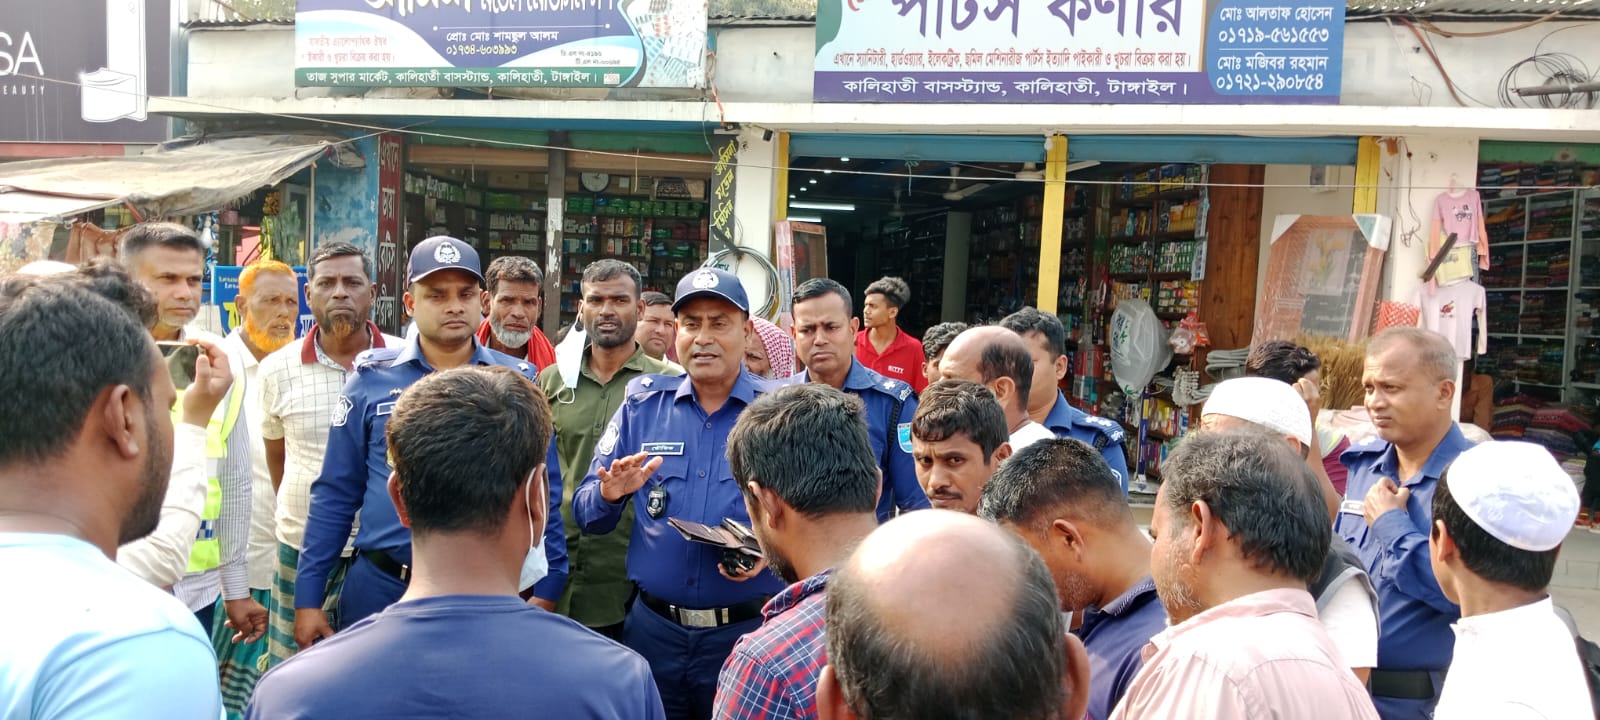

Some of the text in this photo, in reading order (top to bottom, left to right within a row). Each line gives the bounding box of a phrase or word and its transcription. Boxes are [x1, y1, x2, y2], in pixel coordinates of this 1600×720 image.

[1245, 6, 1291, 21] আলতাফ
[1295, 7, 1334, 21] হোসেন
[529, 31, 559, 42] আলম
[1218, 27, 1330, 43] ০১৭১৯-৫৬১৫৫৩
[833, 53, 854, 66] এখানে
[1046, 48, 1070, 67] ইত্যাদি
[1073, 48, 1102, 67] পাইকারী
[1105, 54, 1111, 65] ও
[1114, 53, 1131, 69] খুচরা
[1135, 49, 1155, 67] বিক্রয়
[1158, 53, 1172, 66] করা
[1245, 51, 1286, 71] মজিবর
[1289, 56, 1329, 71] রহমান
[306, 73, 328, 83] তাজ
[330, 72, 356, 84] সুপার
[358, 69, 392, 84] মার্কেট,
[395, 69, 441, 83] কালিহাতী
[496, 69, 547, 84] কালিহাতী,
[550, 69, 591, 83] টাঙ্গাইল
[1216, 73, 1324, 93] ০১৭২১-২৯০৮৫৪
[842, 77, 919, 95] কালিহাতী
[1013, 77, 1100, 97] কালিহাতী,
[1107, 77, 1177, 96] টাঙ্গাইল
